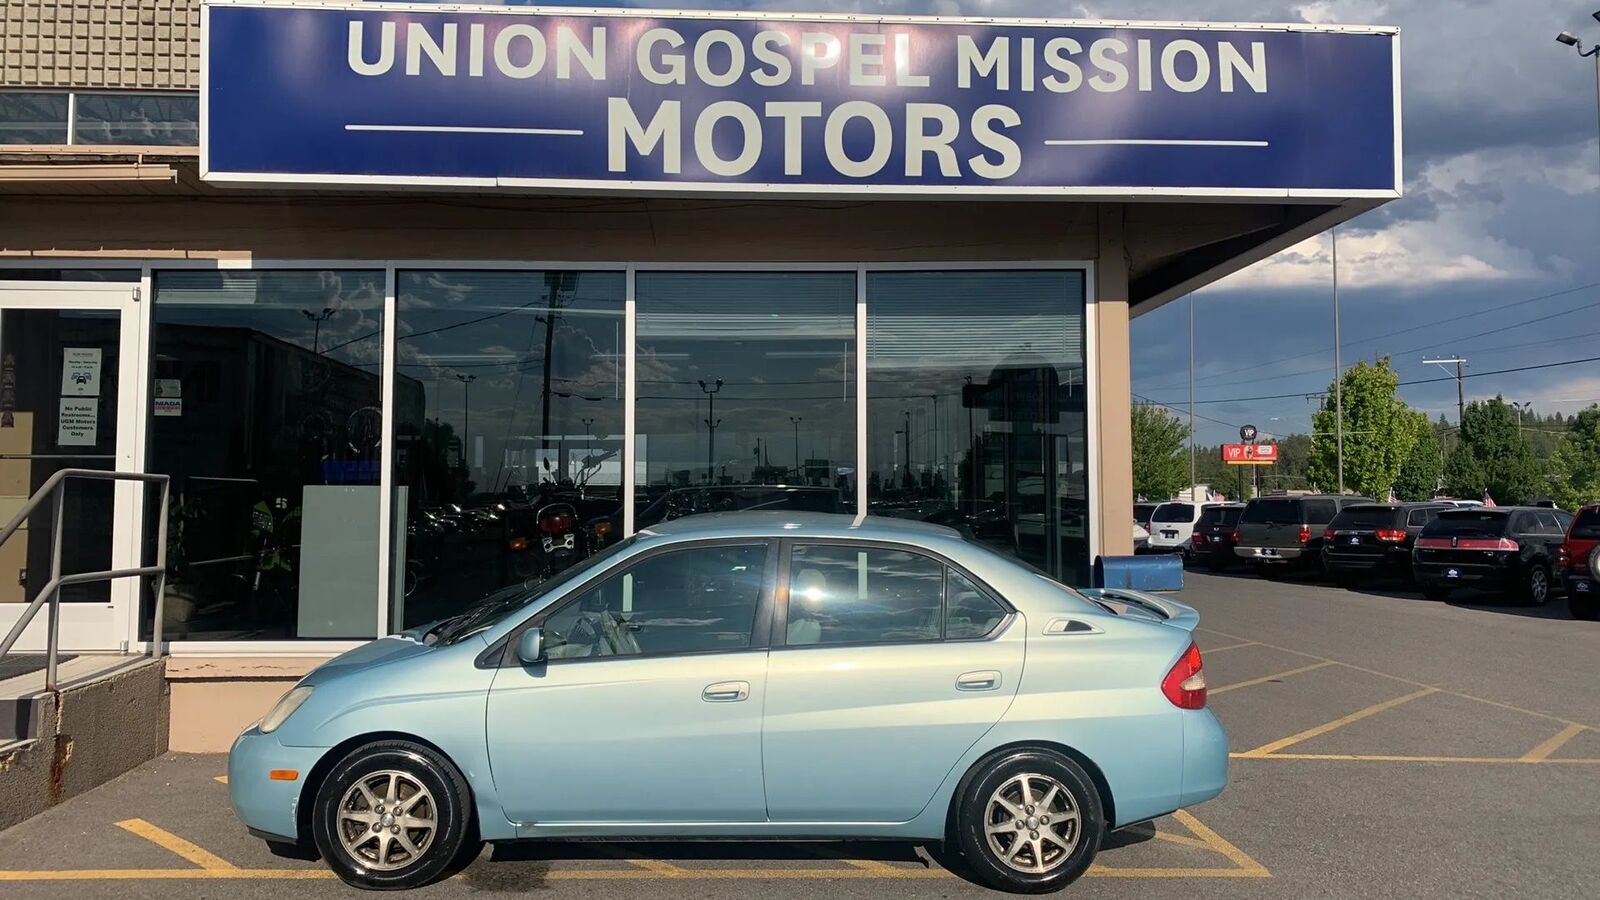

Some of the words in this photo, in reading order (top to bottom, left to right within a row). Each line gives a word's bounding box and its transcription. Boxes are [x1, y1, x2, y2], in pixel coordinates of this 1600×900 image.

[347, 20, 607, 81] UNION
[635, 27, 930, 88] GOSPEL
[957, 34, 1268, 94] MISSION
[607, 96, 1022, 180] MOTORS
[1228, 447, 1241, 458] VIP
